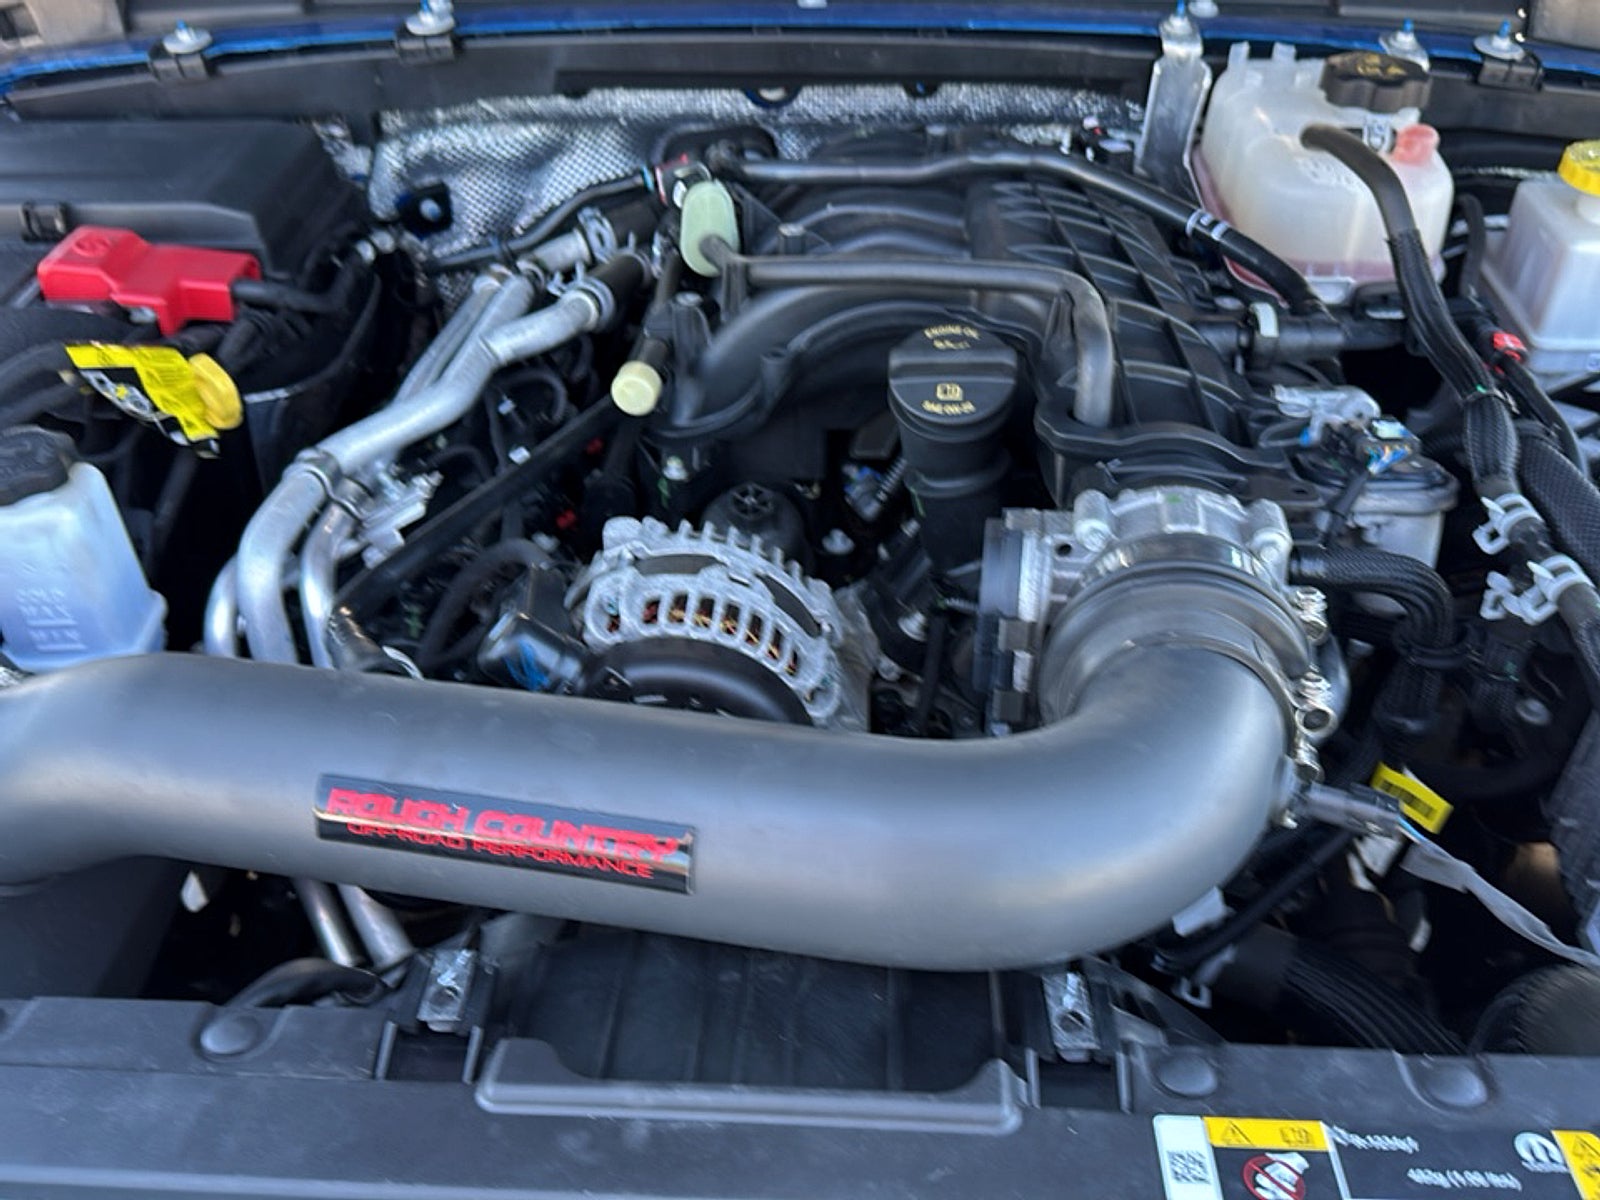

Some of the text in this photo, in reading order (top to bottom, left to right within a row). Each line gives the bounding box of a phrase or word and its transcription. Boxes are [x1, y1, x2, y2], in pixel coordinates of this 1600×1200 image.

[326, 788, 681, 862] ROUGH COUNTRY
[472, 840, 655, 879] PERFORMANCE
